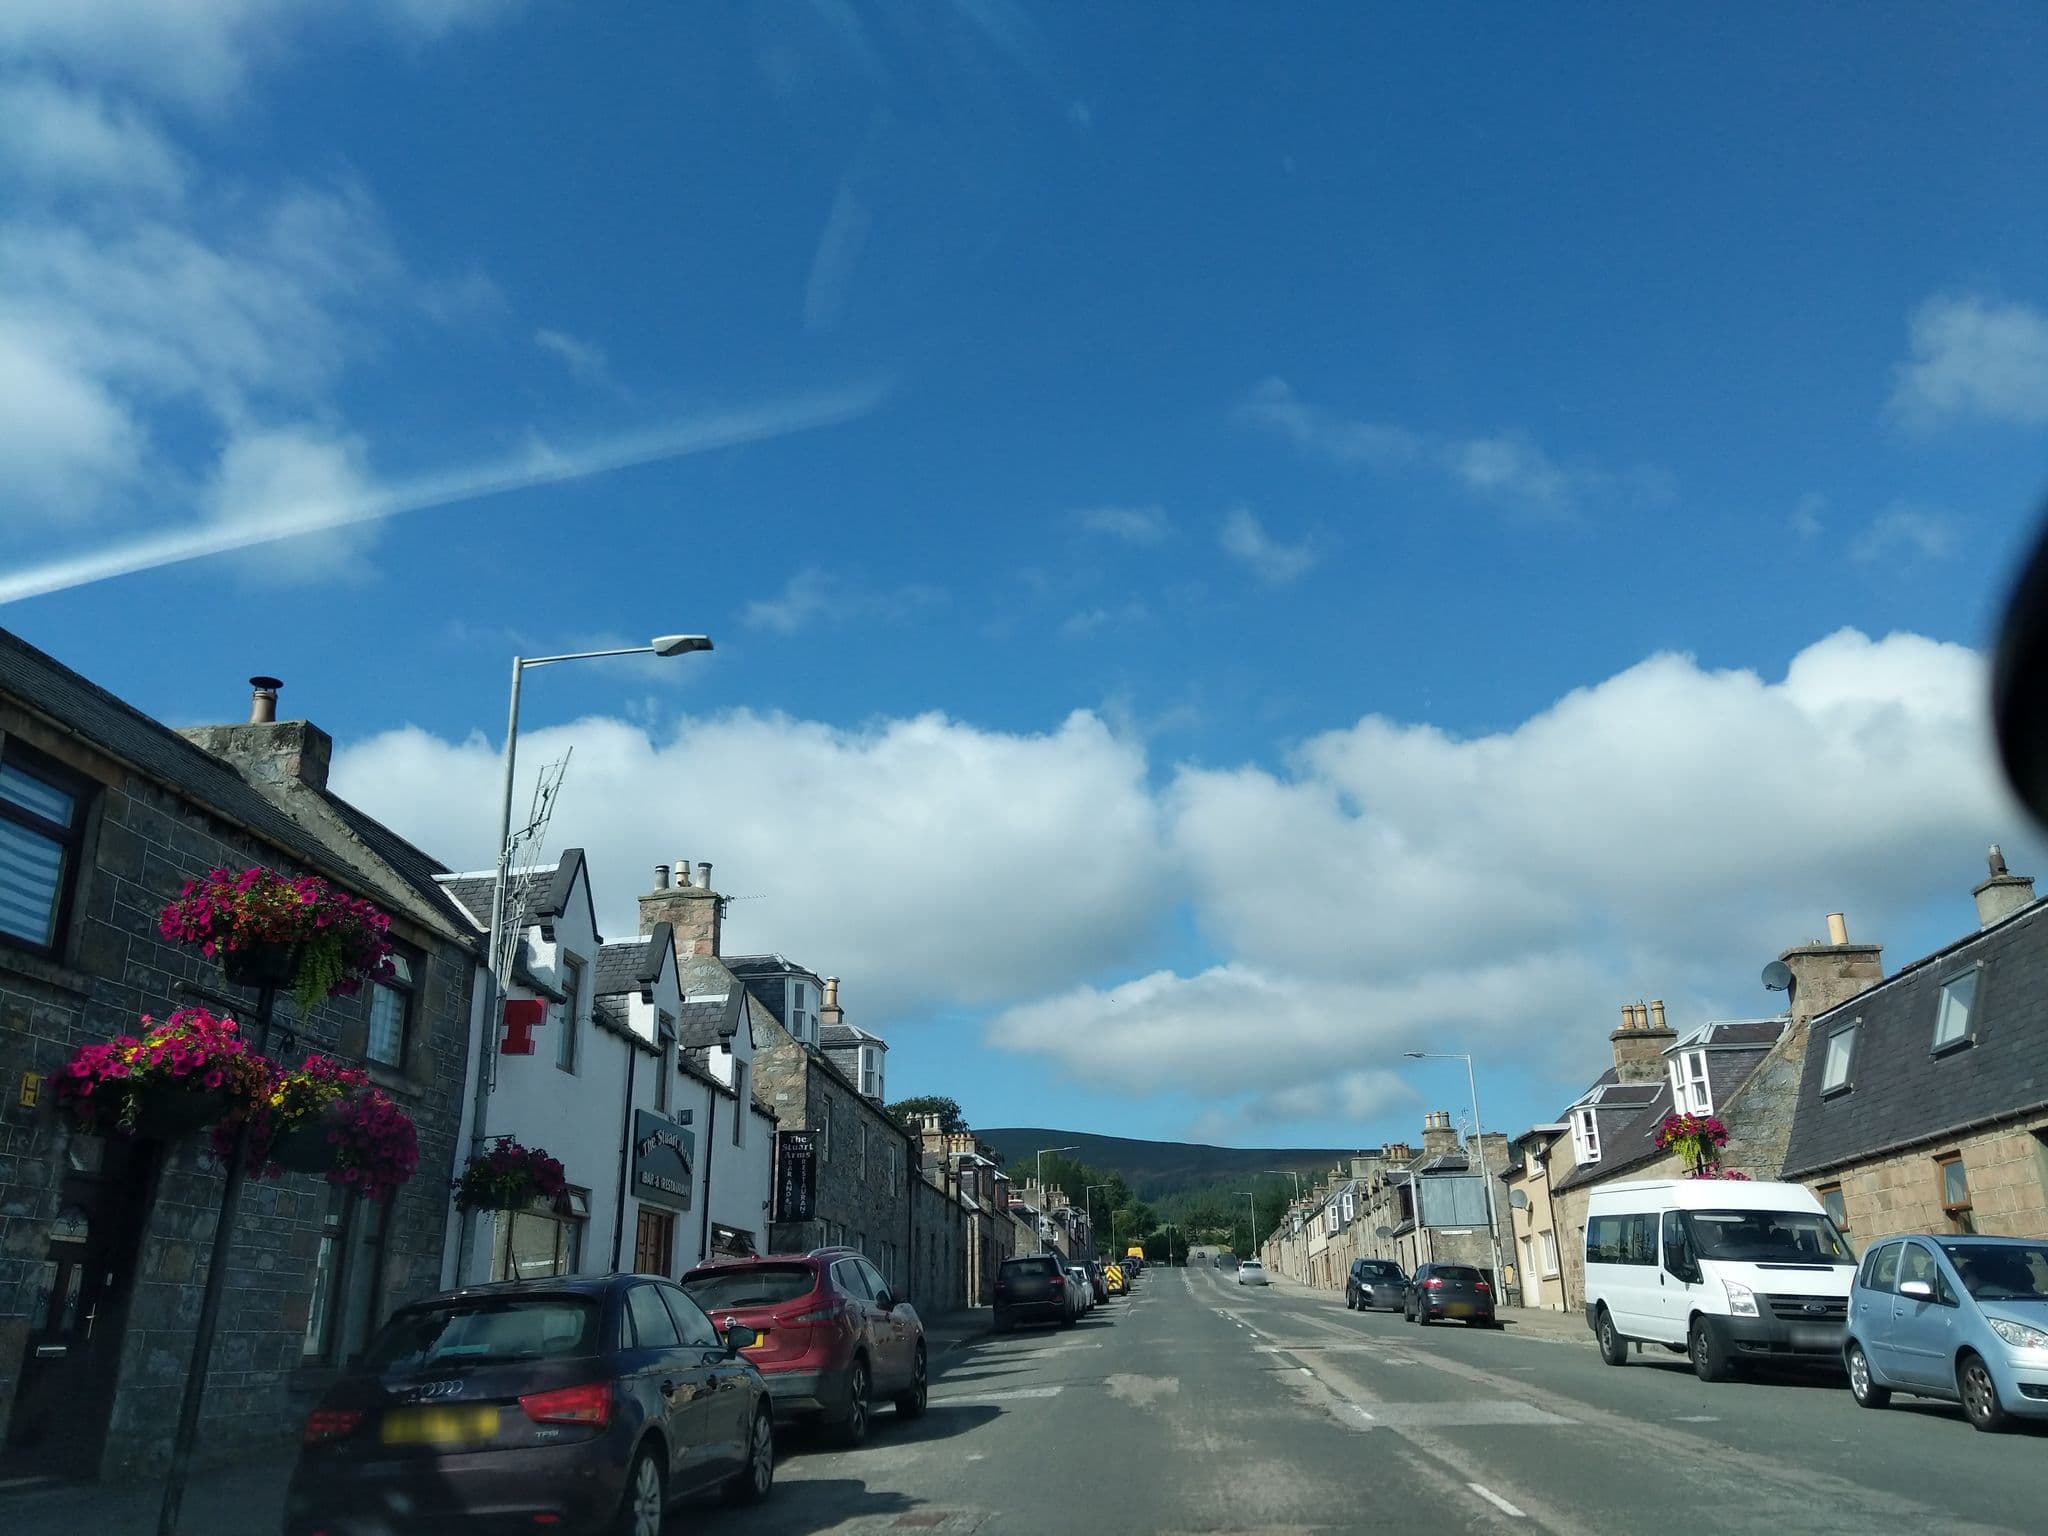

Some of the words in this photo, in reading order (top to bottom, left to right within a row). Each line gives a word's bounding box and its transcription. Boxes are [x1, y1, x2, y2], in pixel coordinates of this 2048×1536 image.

[789, 1135, 807, 1143] The
[643, 1136, 657, 1158] The
[656, 1129, 679, 1149] Stuart
[782, 1143, 813, 1151] Stuart
[784, 1151, 811, 1159] Arms
[642, 1170, 654, 1185] BAR
